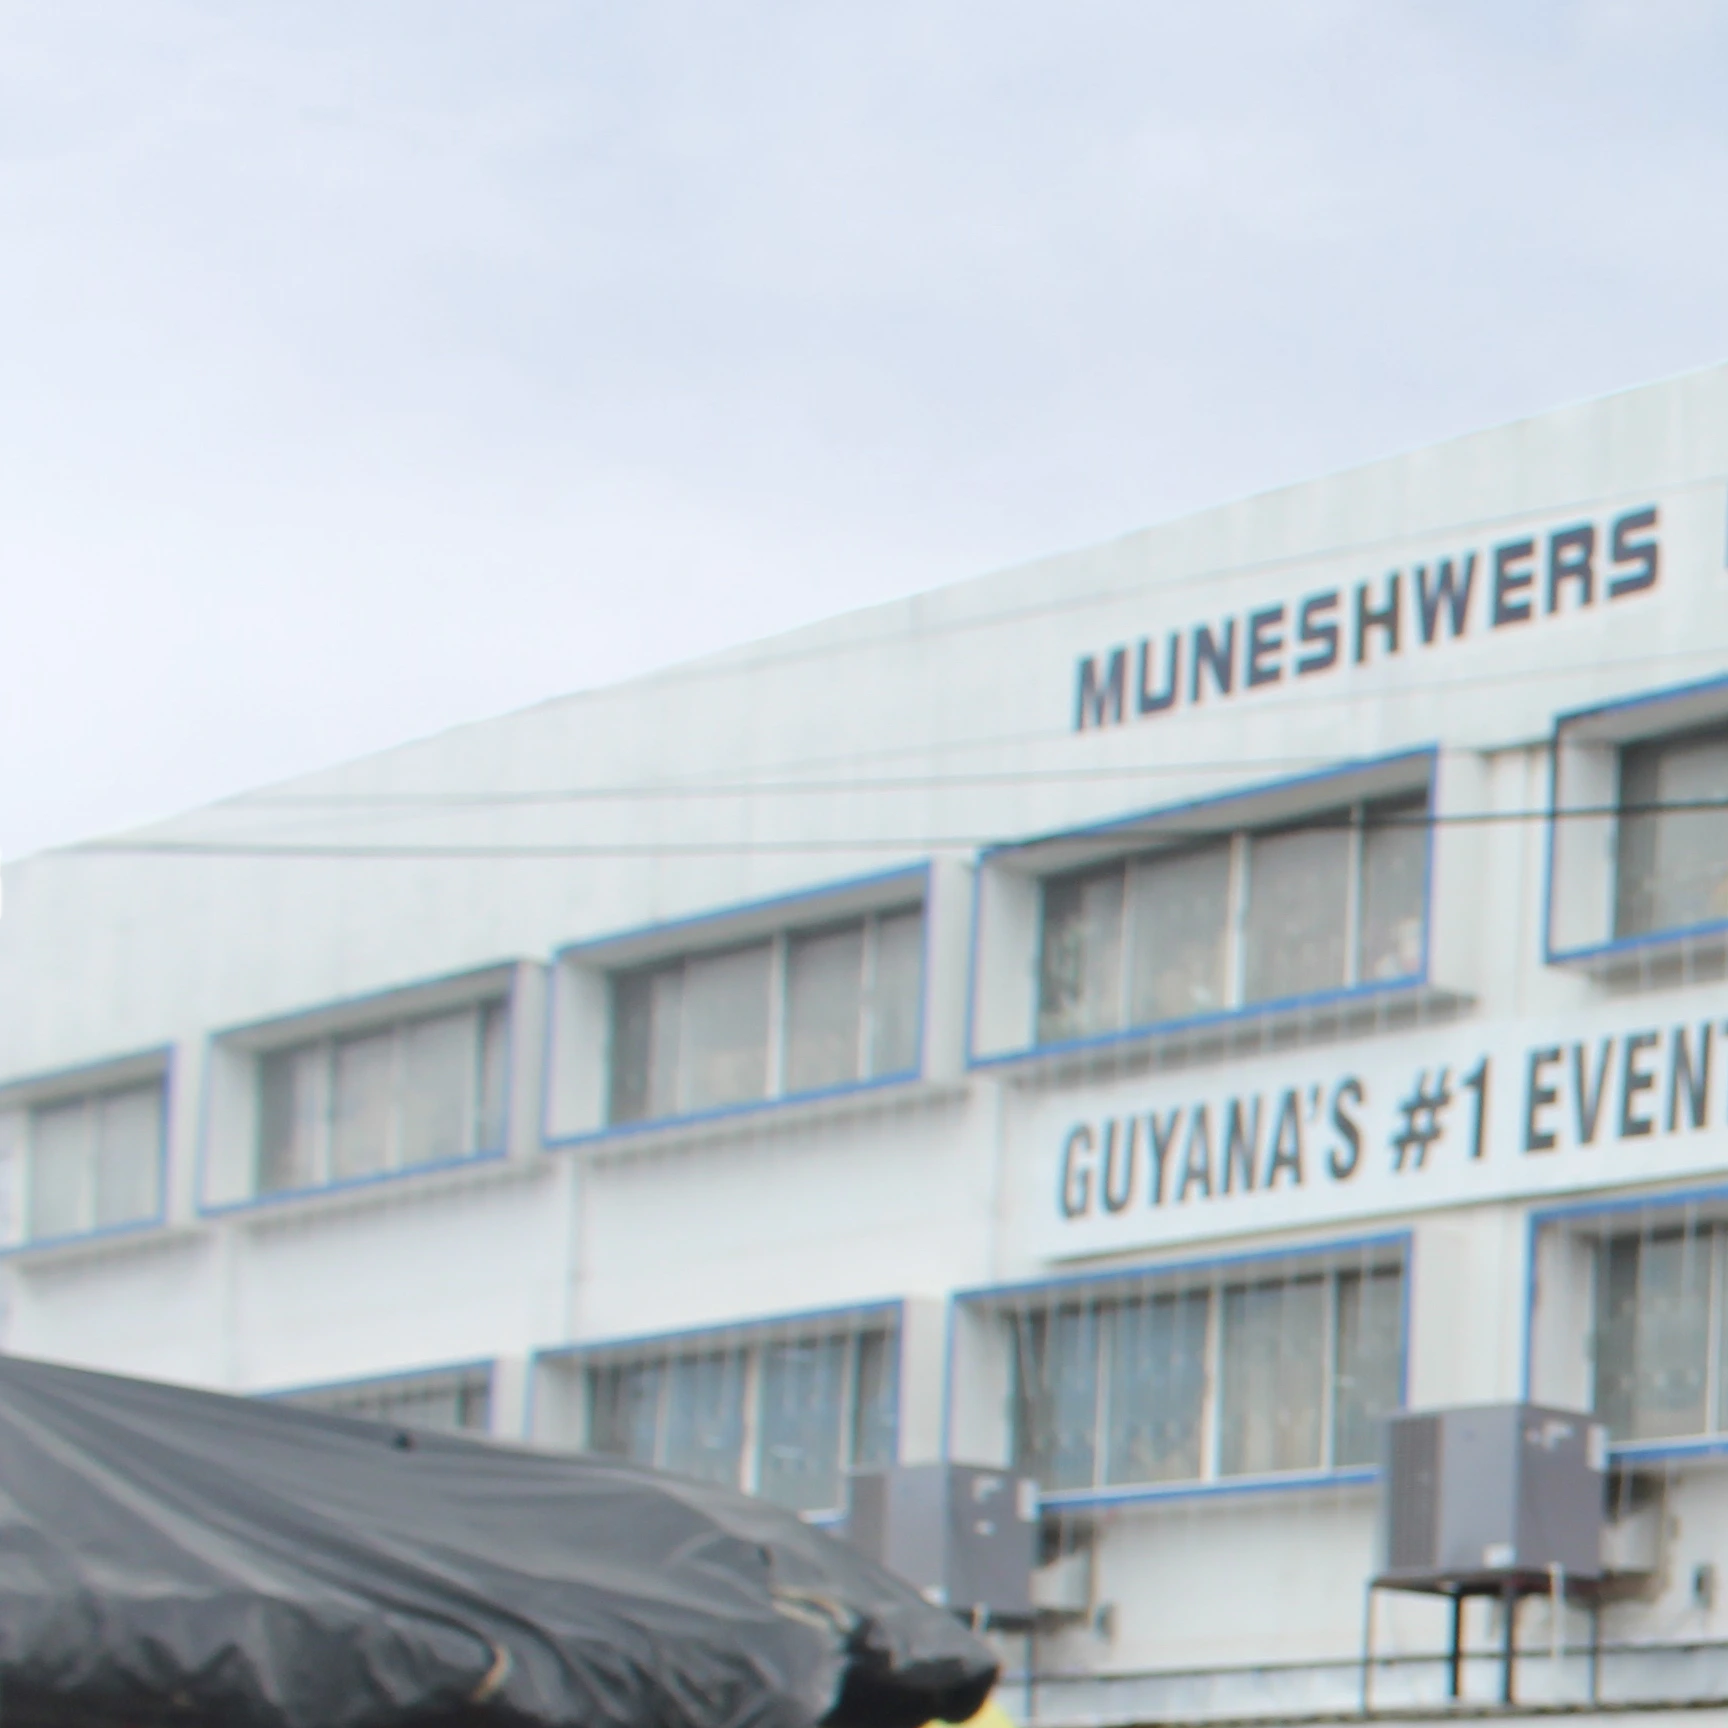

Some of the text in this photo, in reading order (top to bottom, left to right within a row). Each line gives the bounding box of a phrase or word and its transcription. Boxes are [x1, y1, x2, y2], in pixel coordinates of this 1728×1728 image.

[1074, 506, 1661, 732] MUNESHWERS
[1060, 1077, 1366, 1221] GUYANA'S
[1391, 1056, 1490, 1172] #1
